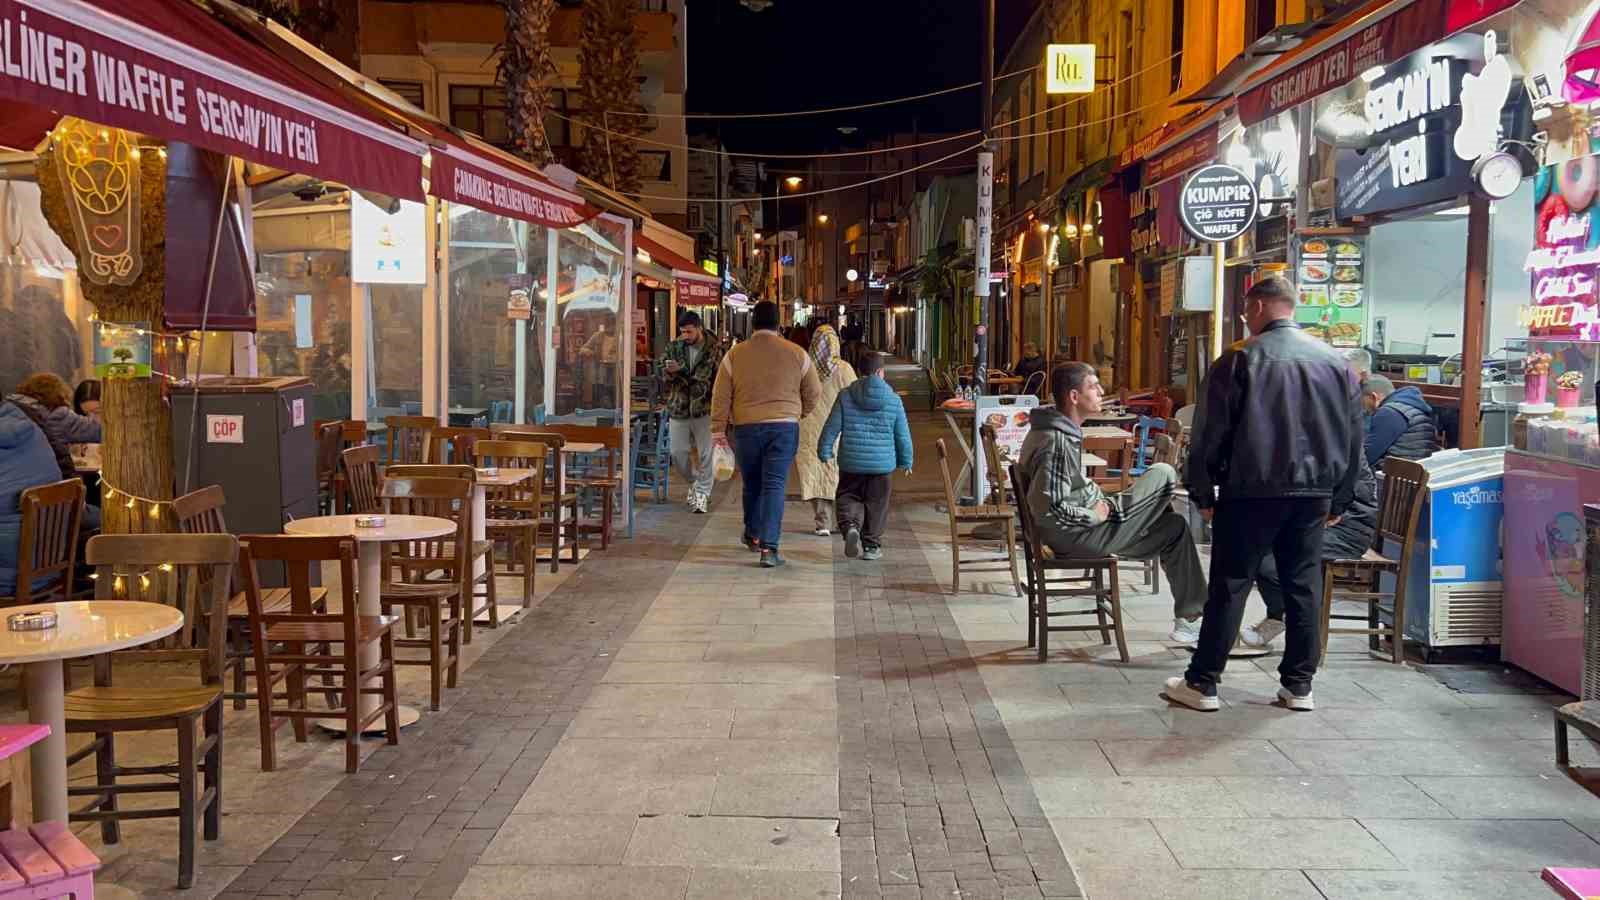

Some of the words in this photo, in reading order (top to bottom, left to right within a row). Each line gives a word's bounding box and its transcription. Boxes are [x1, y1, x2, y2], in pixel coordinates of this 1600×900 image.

[0, 10, 87, 96] LİNER
[92, 50, 187, 125] WAFFLE
[285, 120, 319, 164] YERİ
[1389, 117, 1427, 188] YERİ
[1217, 207, 1245, 219] KÖFTE
[1203, 224, 1238, 234] WAFFLE
[213, 418, 237, 439] ÇÖP
